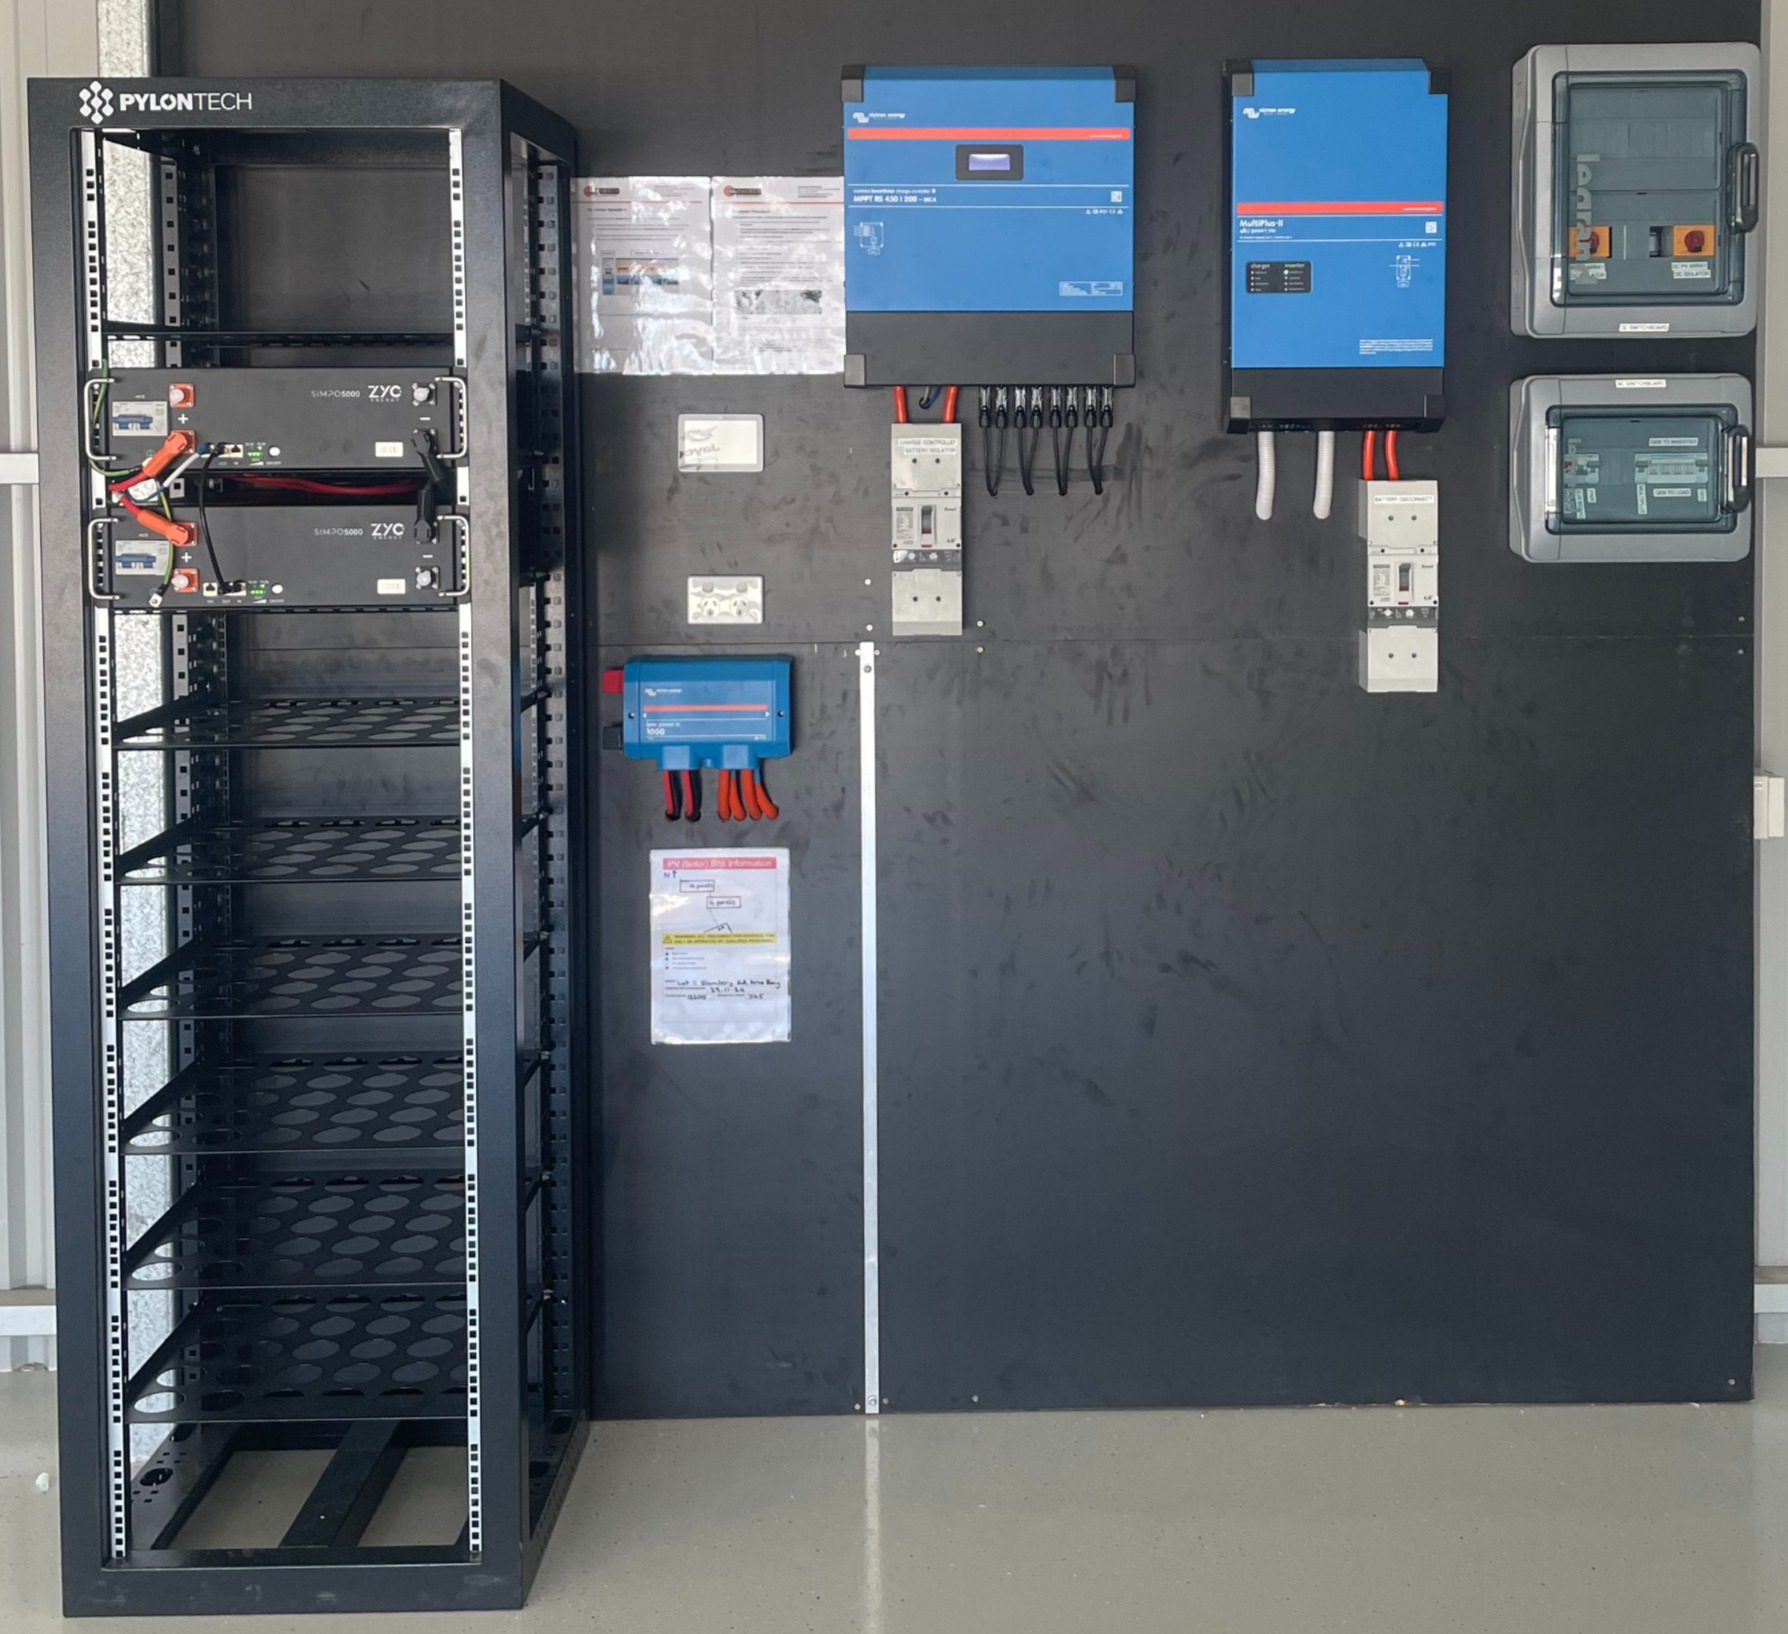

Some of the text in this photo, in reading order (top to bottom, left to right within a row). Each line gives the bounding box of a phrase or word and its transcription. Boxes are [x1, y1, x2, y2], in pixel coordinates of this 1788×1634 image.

[119, 93, 252, 111] PYLONTECH
[1239, 219, 1284, 227] MultiPlus-II
[368, 385, 402, 398] ZYC
[371, 523, 406, 536] ZYC
[667, 859, 680, 868] PV
[682, 859, 709, 868] (Solar)
